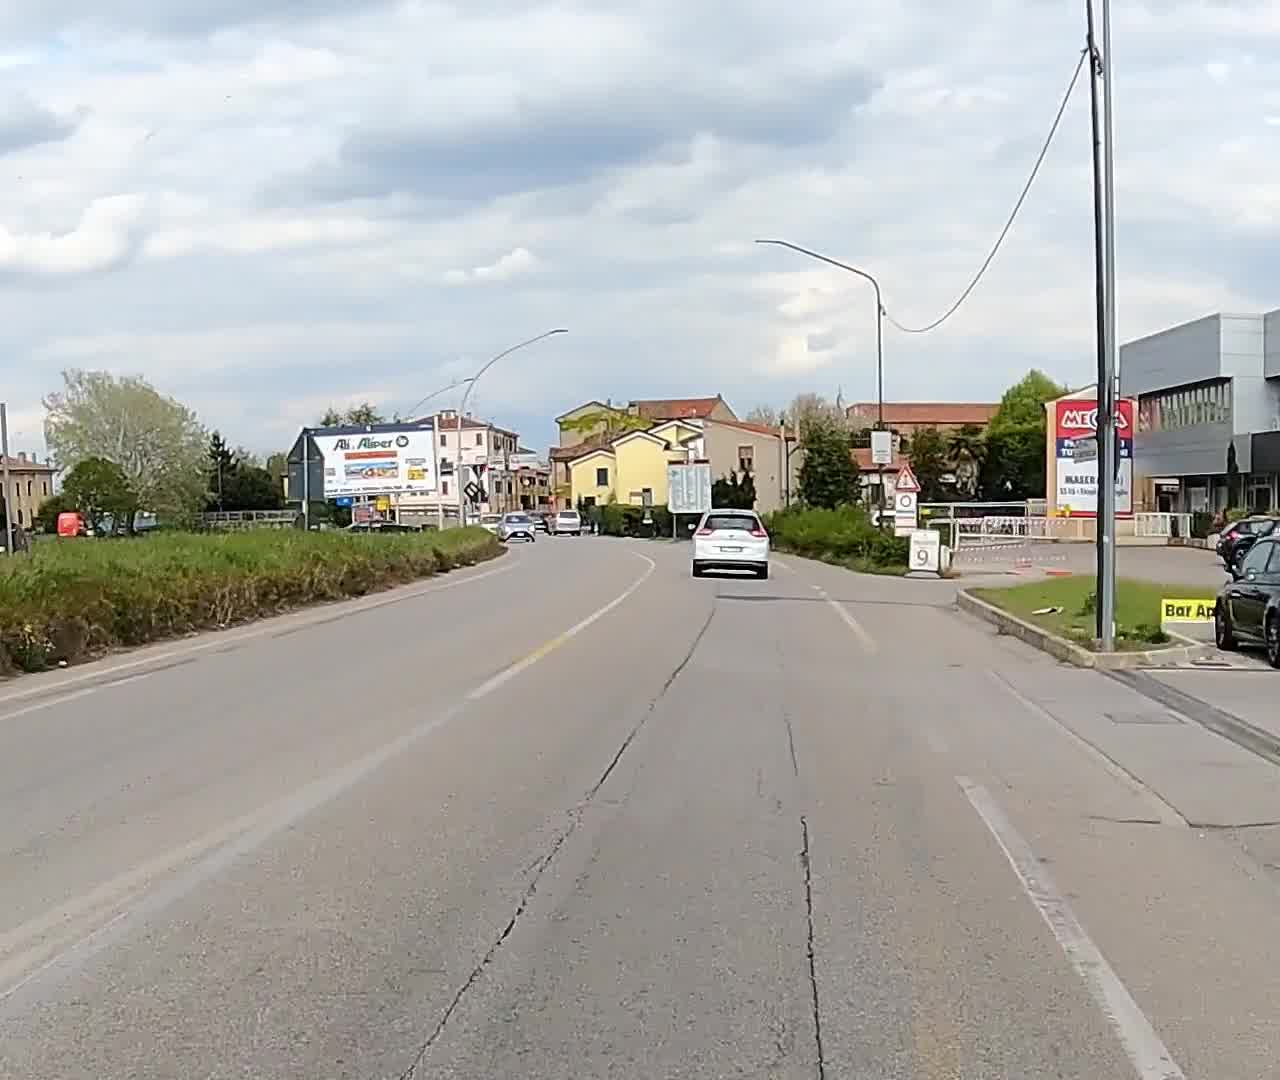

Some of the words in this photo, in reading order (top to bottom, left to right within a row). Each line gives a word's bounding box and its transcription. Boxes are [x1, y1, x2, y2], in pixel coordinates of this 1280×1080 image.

[917, 549, 928, 566] 9
[1166, 604, 1192, 617] Bar
[1196, 604, 1217, 621] Ap
